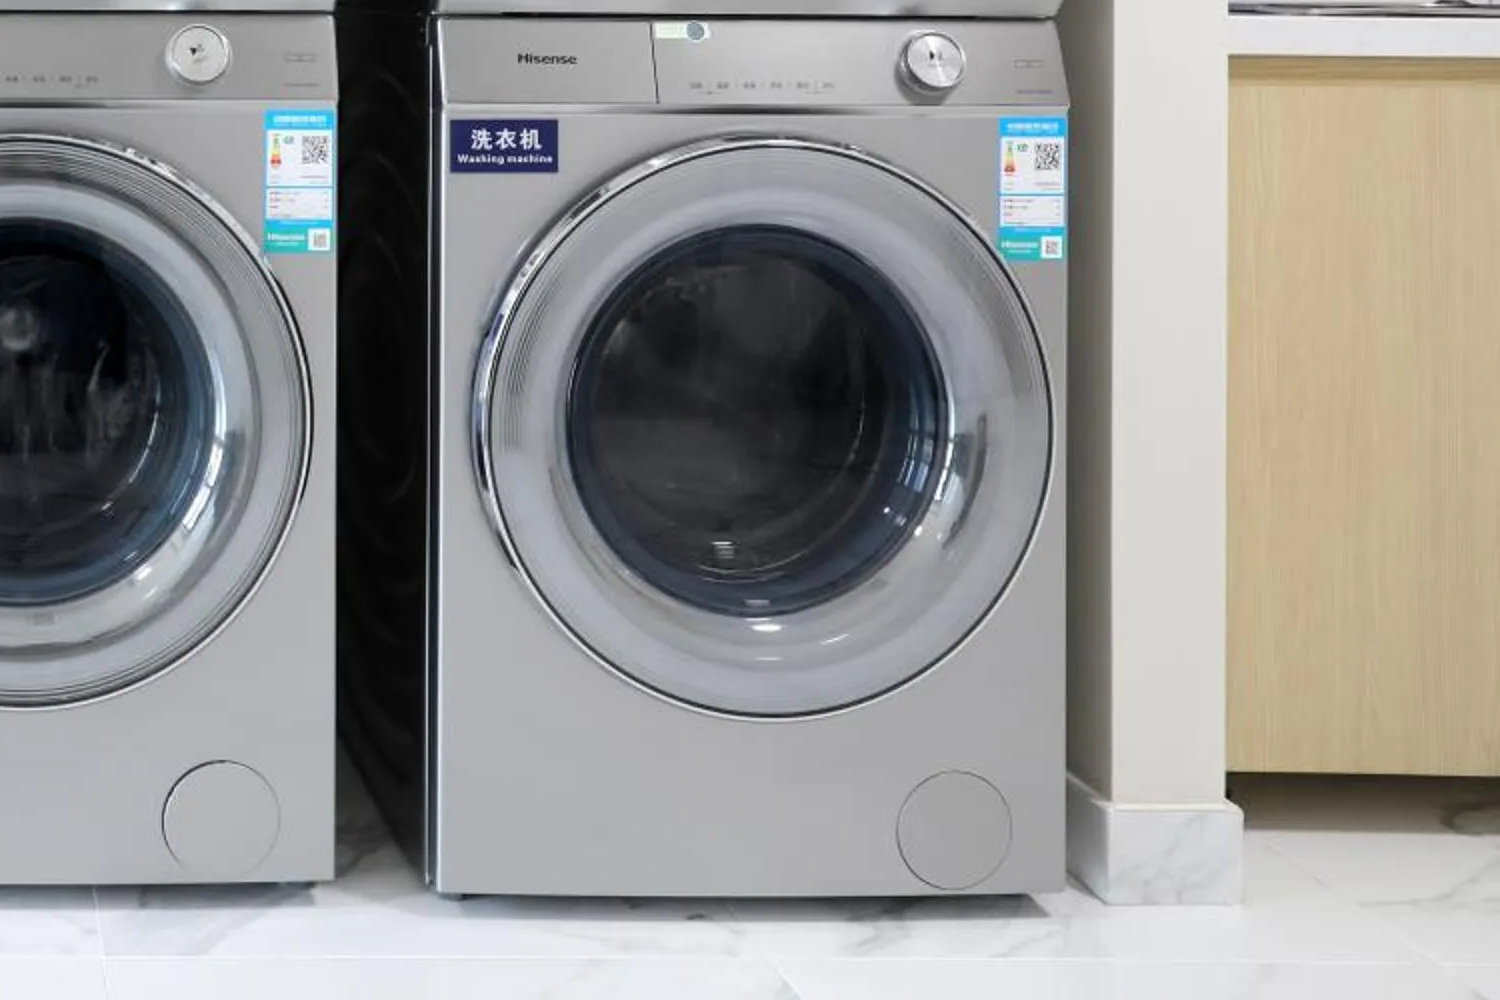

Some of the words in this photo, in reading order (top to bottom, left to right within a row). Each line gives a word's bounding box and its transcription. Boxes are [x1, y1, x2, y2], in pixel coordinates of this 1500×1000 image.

[517, 52, 578, 65] Hisense
[470, 127, 542, 150] 洗衣机
[457, 153, 505, 165] Washing
[507, 153, 553, 163] machine
